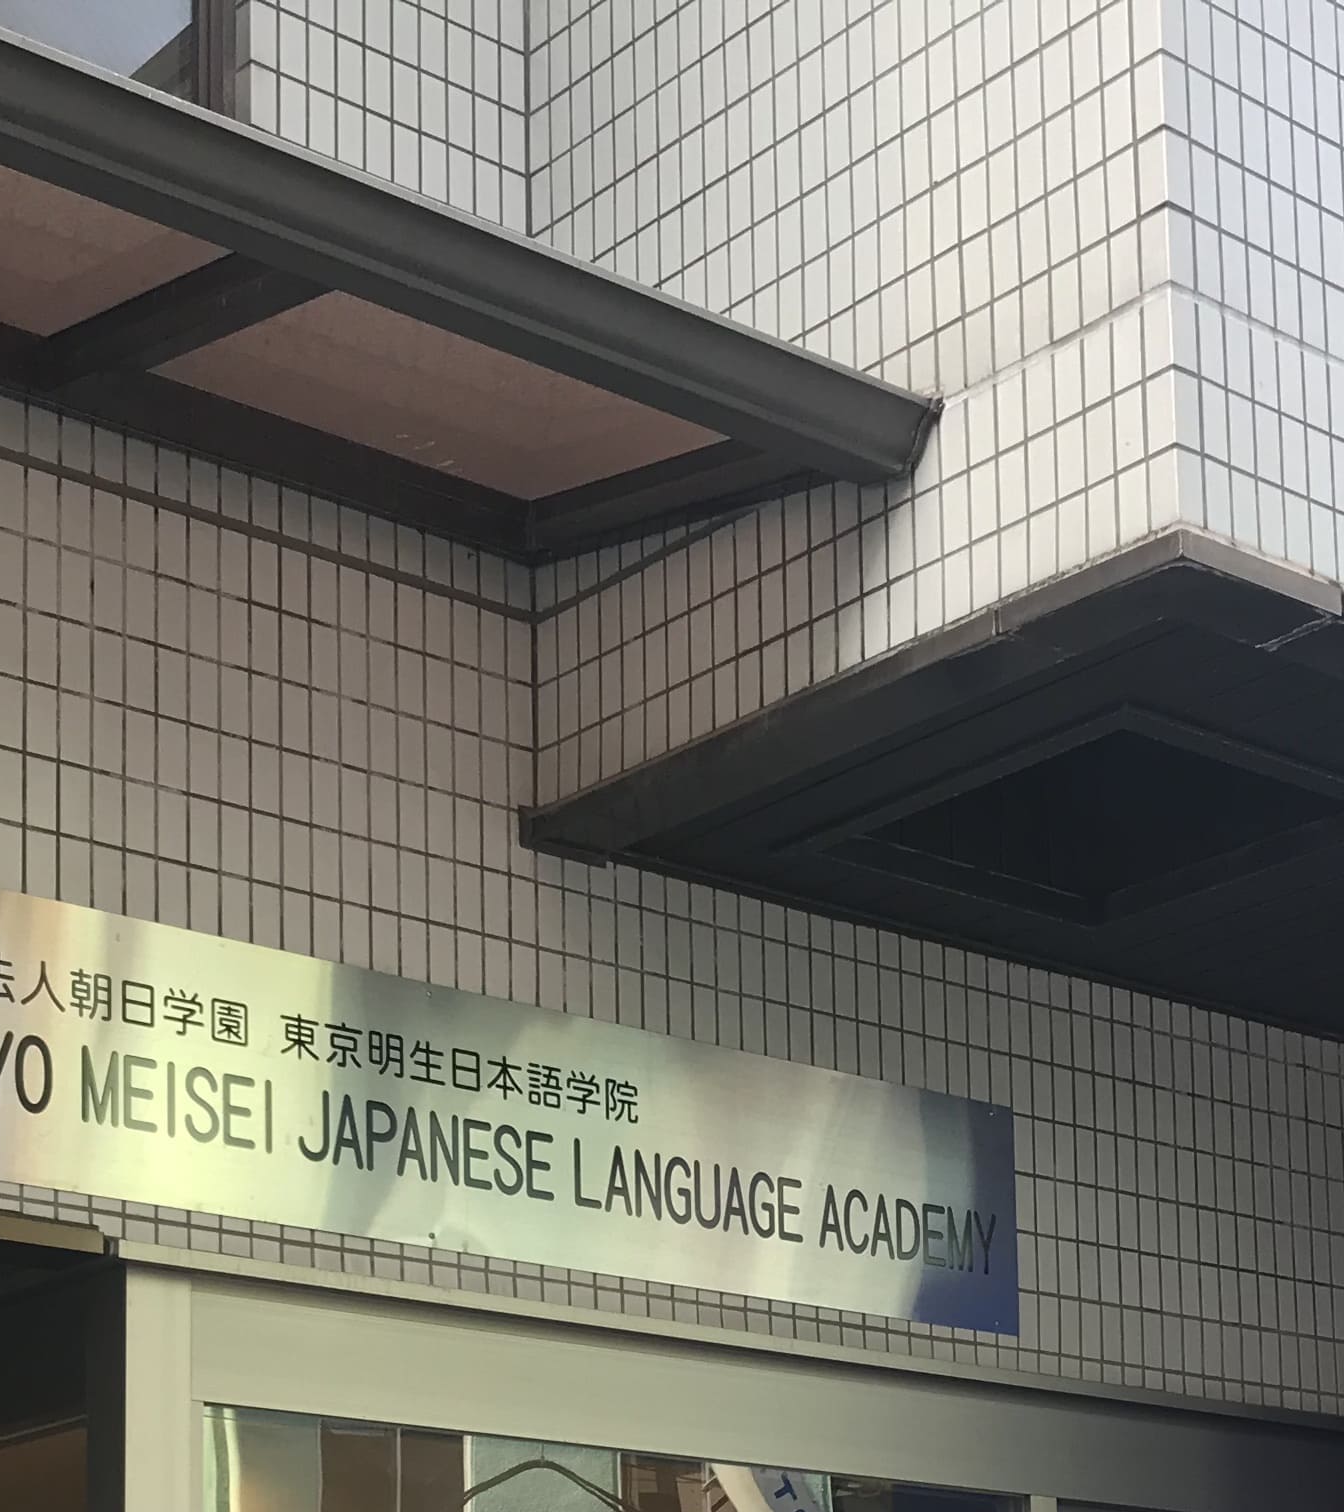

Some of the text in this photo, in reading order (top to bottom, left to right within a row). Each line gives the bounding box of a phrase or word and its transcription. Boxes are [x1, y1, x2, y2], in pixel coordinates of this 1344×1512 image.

[279, 1013, 640, 1125] 東京明生日本語学院
[80, 1044, 275, 1155] MEISEI
[298, 1090, 554, 1202] JAPANESE
[573, 1137, 804, 1245] LANGUAGE
[818, 1183, 997, 1277] ACADEMY
